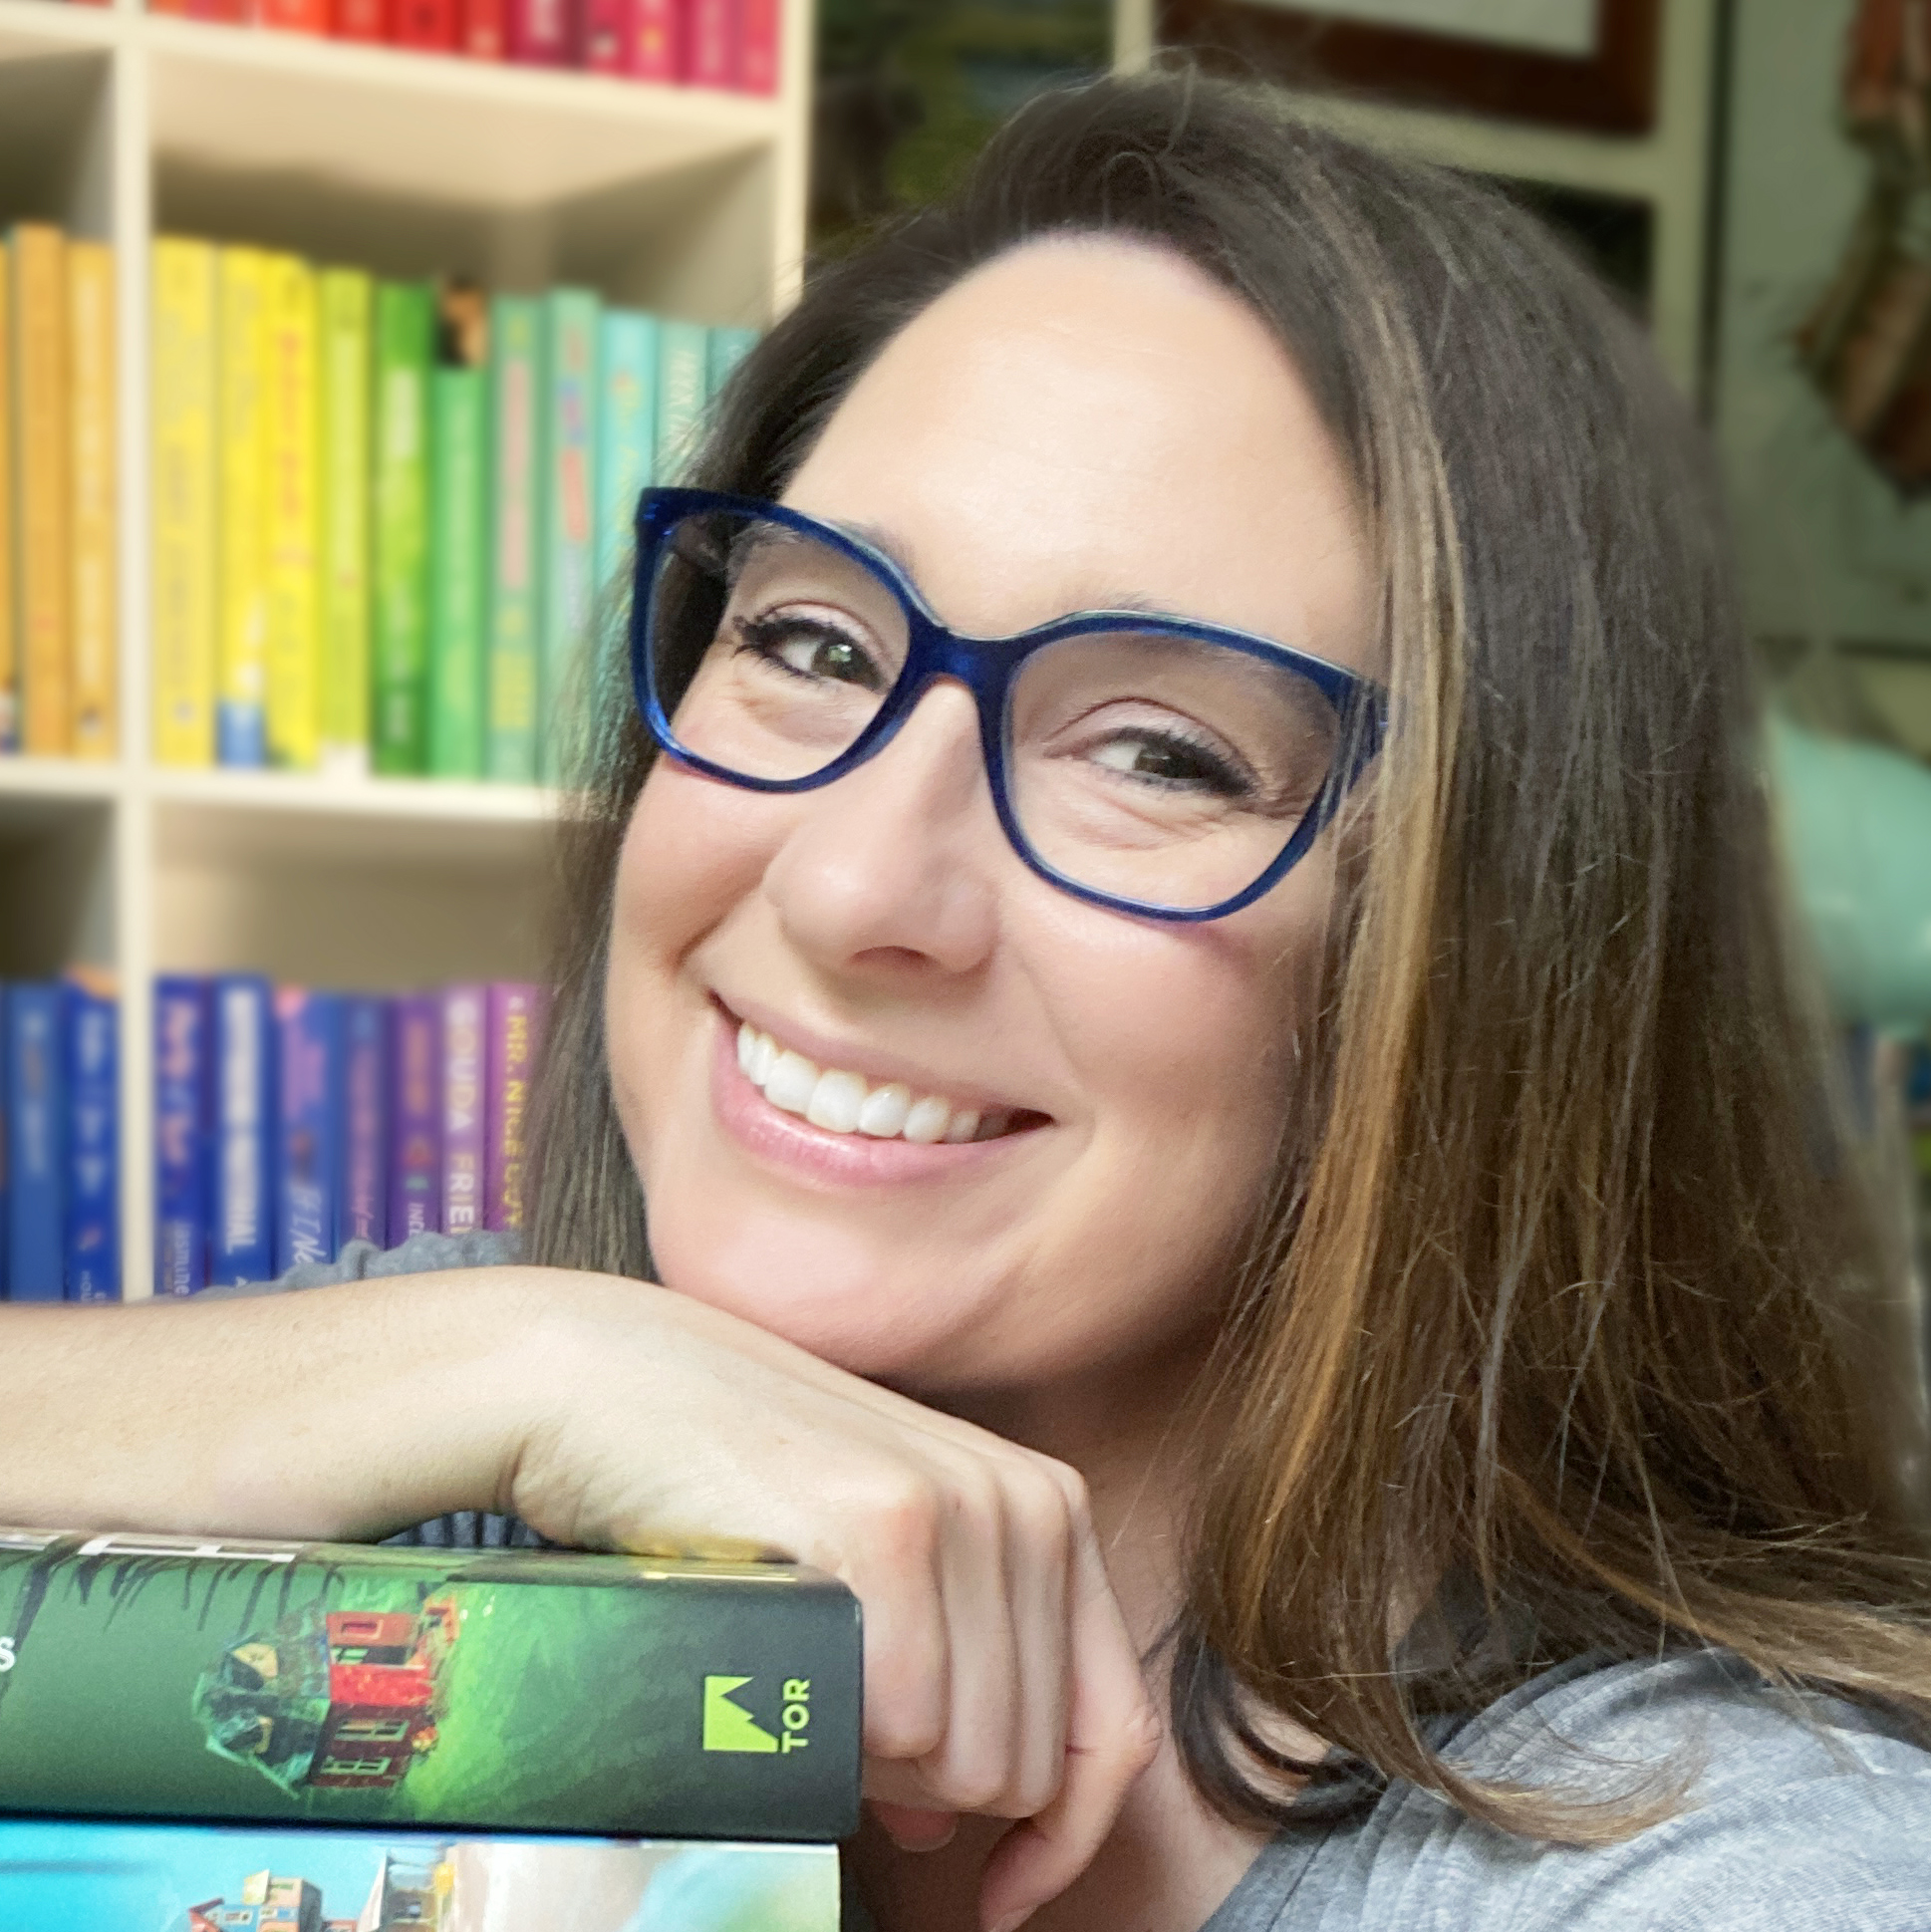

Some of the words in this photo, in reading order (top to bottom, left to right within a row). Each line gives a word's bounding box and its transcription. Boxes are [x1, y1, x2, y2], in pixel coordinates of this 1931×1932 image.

[447, 997, 476, 1133] GOUDA
[505, 1014, 528, 1073] MR.
[781, 1678, 811, 1754] TOR
